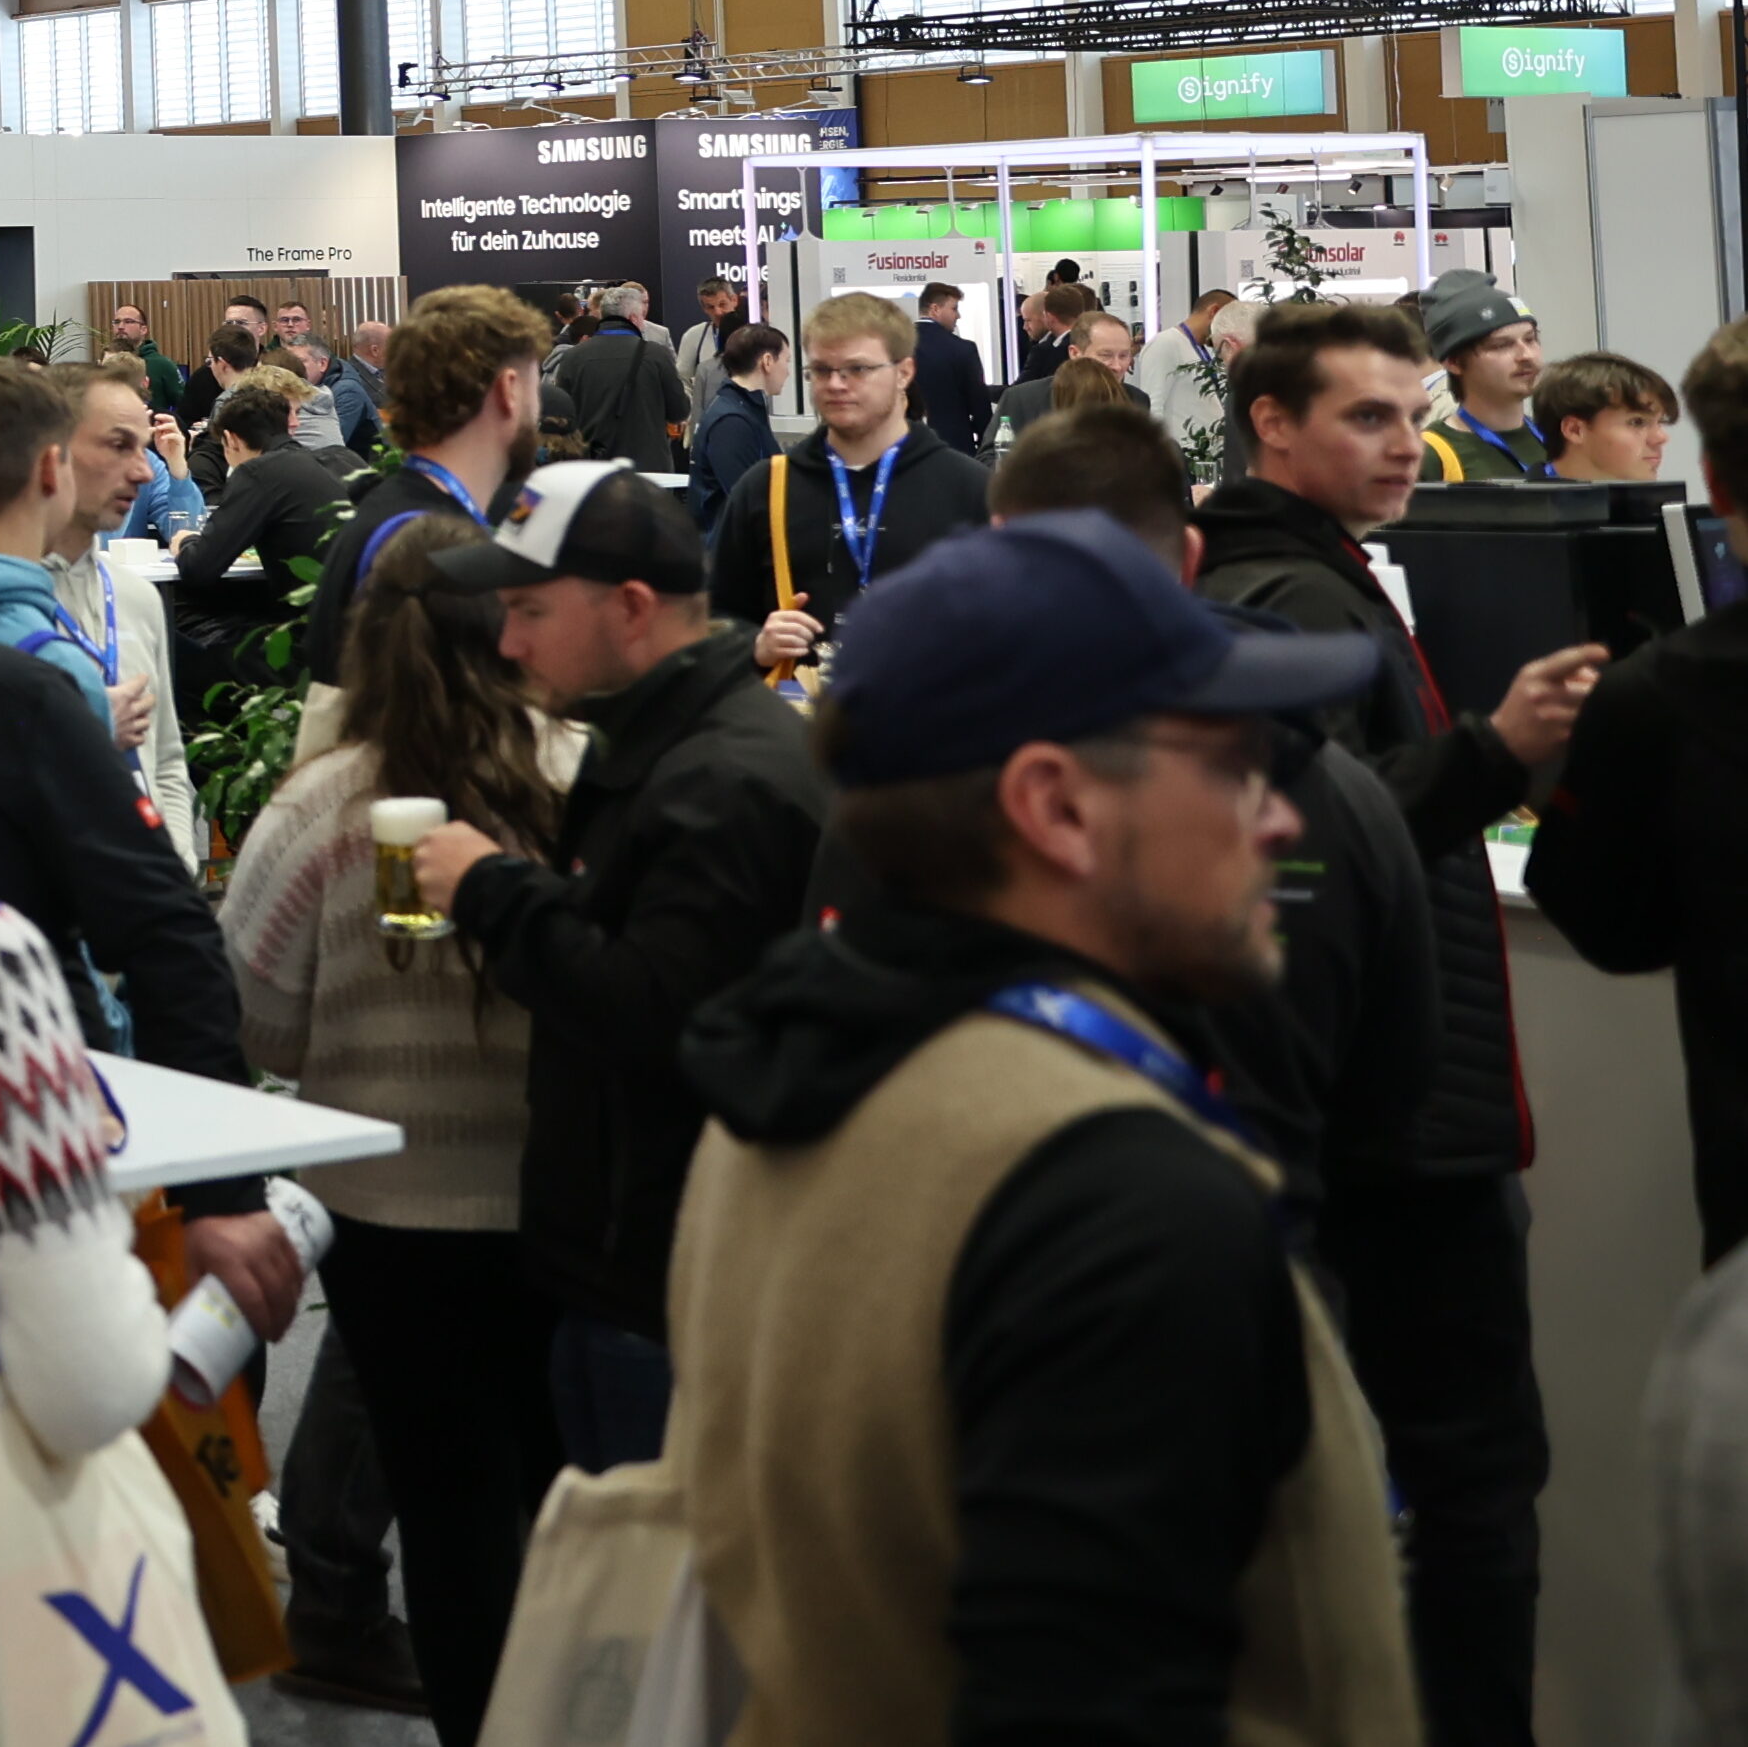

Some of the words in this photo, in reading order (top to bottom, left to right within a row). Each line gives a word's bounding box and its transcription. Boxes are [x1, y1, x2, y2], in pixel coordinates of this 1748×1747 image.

[538, 135, 647, 164] SAMSUNG
[698, 133, 811, 158] SAMSUNG
[421, 196, 515, 223] Intelligente
[519, 190, 631, 218] Technologie
[451, 231, 476, 252] für
[480, 230, 518, 251] dein
[522, 230, 600, 250] Zuhause
[689, 226, 747, 246] meets
[247, 247, 274, 262] The
[278, 247, 325, 261] Frame
[329, 247, 352, 261] Pro
